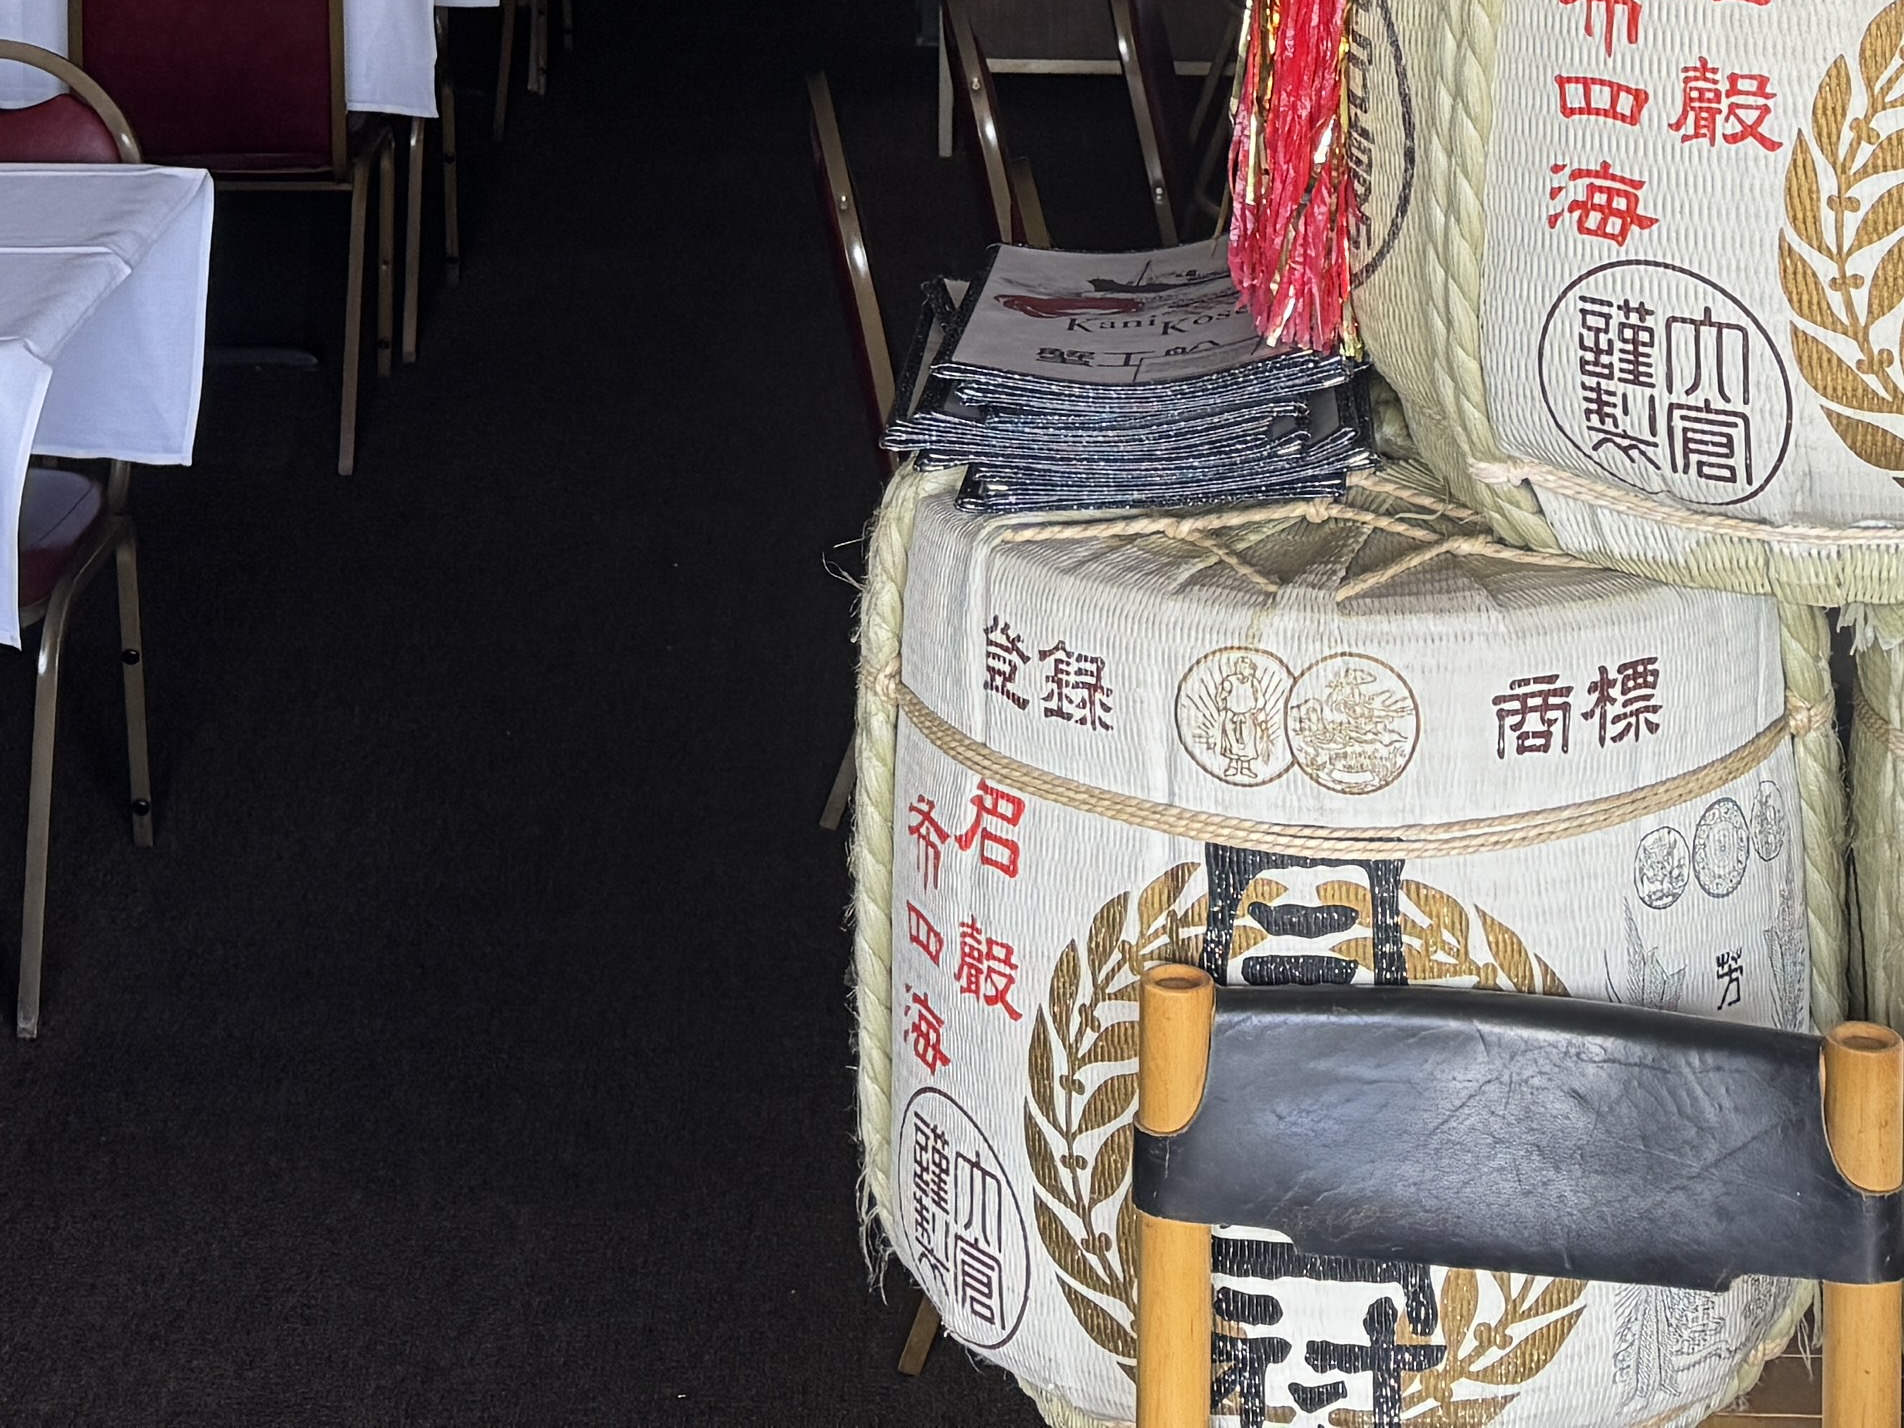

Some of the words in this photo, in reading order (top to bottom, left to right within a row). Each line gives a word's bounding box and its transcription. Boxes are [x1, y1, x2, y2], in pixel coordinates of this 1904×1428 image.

[1066, 315, 1156, 333] Kani
[983, 614, 1113, 730] 登録
[1491, 657, 1661, 759] 商標
